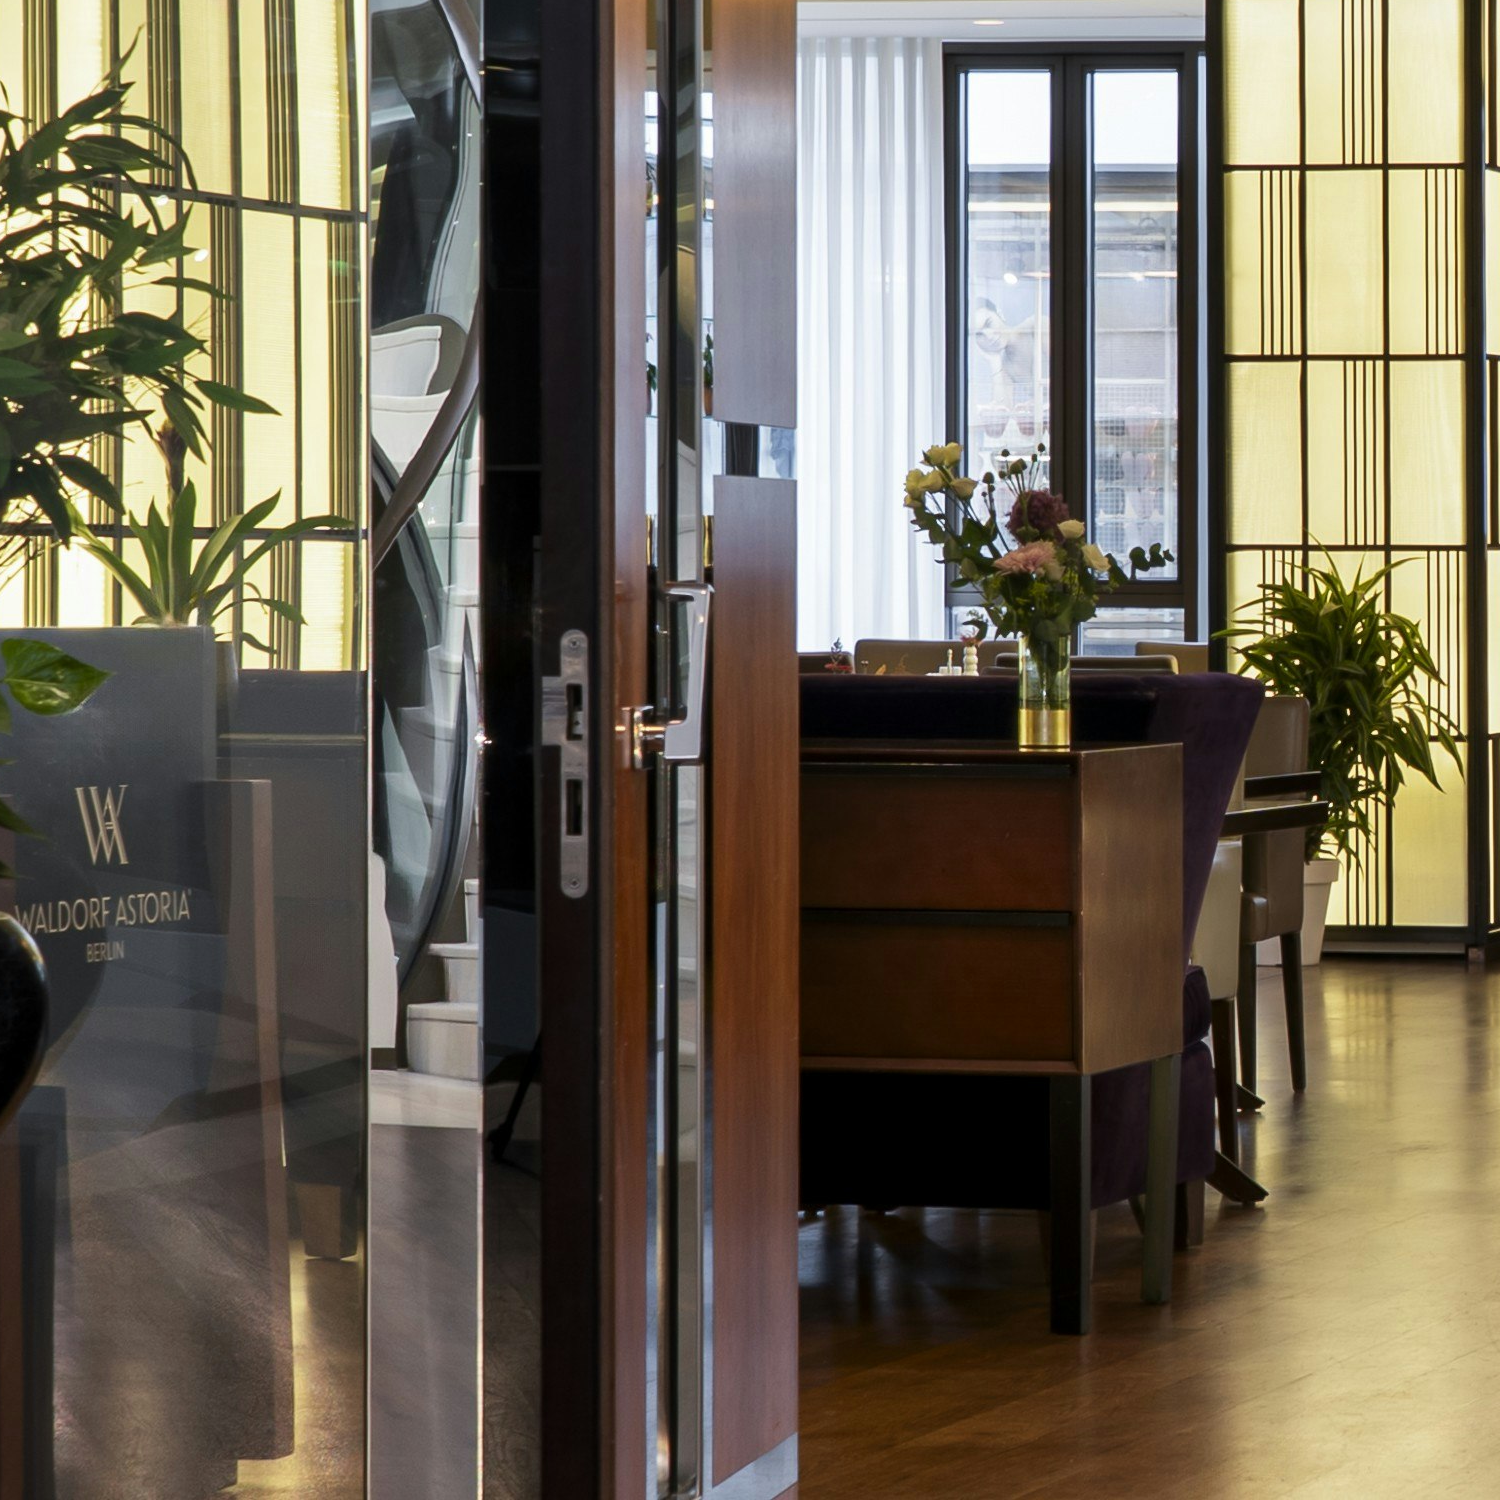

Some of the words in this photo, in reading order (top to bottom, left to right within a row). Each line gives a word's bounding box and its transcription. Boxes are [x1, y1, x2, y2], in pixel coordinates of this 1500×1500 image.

[13, 896, 111, 934] WALDORF
[115, 889, 191, 927] ASTORIA
[86, 940, 125, 963] BERLIN
